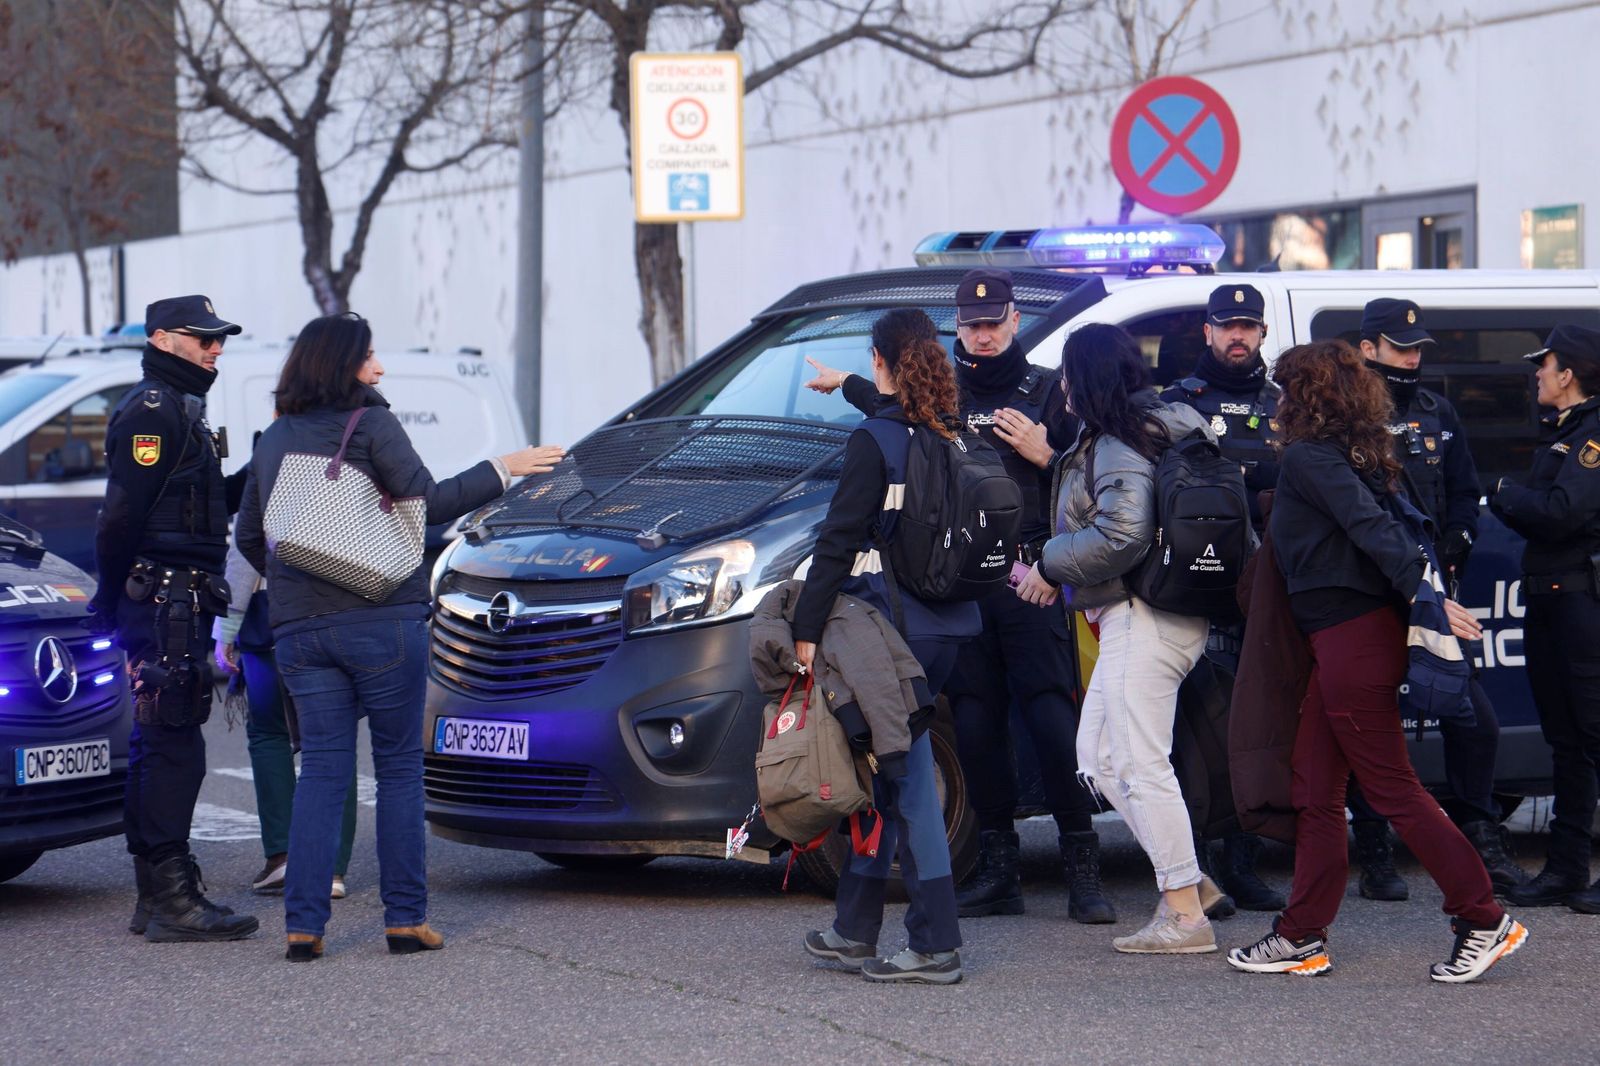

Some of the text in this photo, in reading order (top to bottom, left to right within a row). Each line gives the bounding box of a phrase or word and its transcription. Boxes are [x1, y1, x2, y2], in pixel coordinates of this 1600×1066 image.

[646, 82, 728, 94] CICLOCALLE
[676, 111, 700, 126] 30
[658, 143, 718, 155] CALZADA
[646, 158, 731, 170] COMPARTIDA
[988, 559, 1006, 568] Guardia
[26, 745, 108, 779] CNP3607BC
